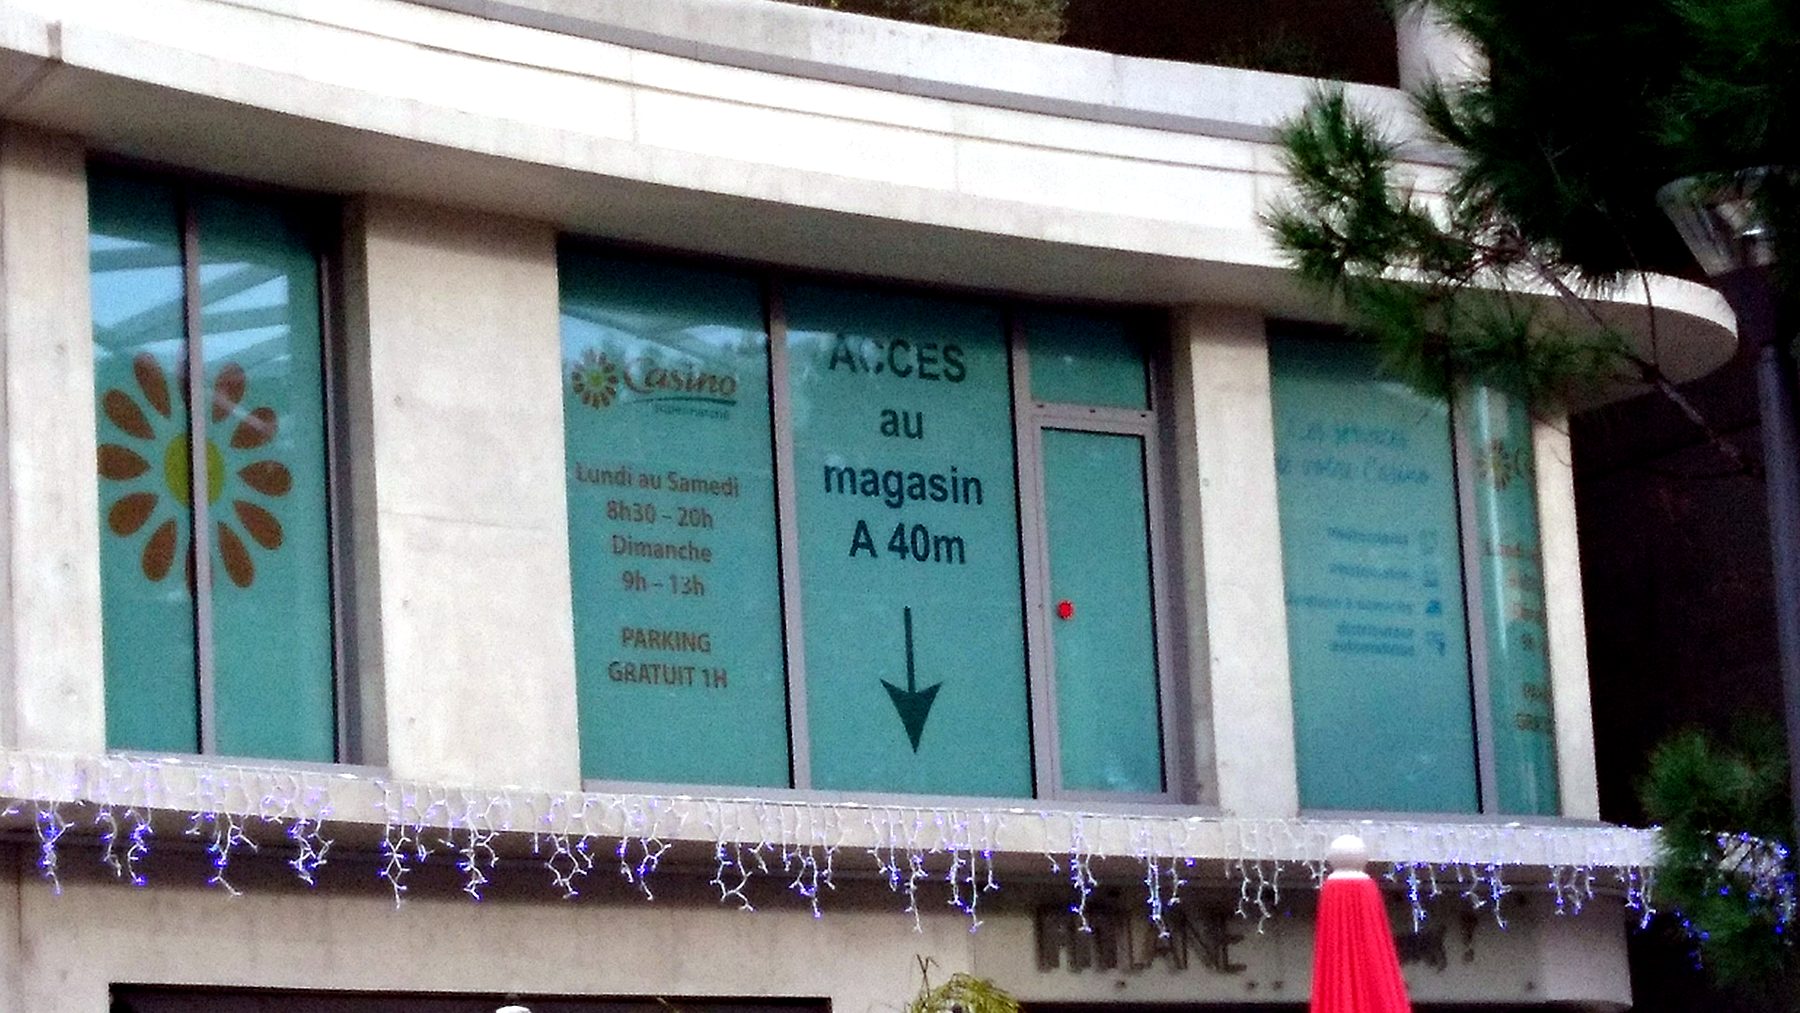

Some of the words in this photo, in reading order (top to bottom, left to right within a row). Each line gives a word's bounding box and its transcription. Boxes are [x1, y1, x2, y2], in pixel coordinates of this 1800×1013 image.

[829, 333, 966, 383] ACCES
[623, 355, 737, 396] Casino
[880, 408, 923, 440] au
[575, 462, 632, 487] Lundi
[638, 472, 661, 490] au
[667, 471, 738, 497] Samedi
[824, 465, 983, 509] magasin
[607, 500, 655, 524] 8h30
[677, 507, 713, 529] 20h
[612, 534, 712, 563] Dimanche
[849, 519, 878, 558] A
[887, 522, 966, 564] 40m
[621, 570, 647, 592] 9h
[669, 573, 705, 596] 13h
[621, 626, 711, 653] PARKING
[608, 660, 695, 686] GRATUIT
[702, 667, 727, 689] 1H
